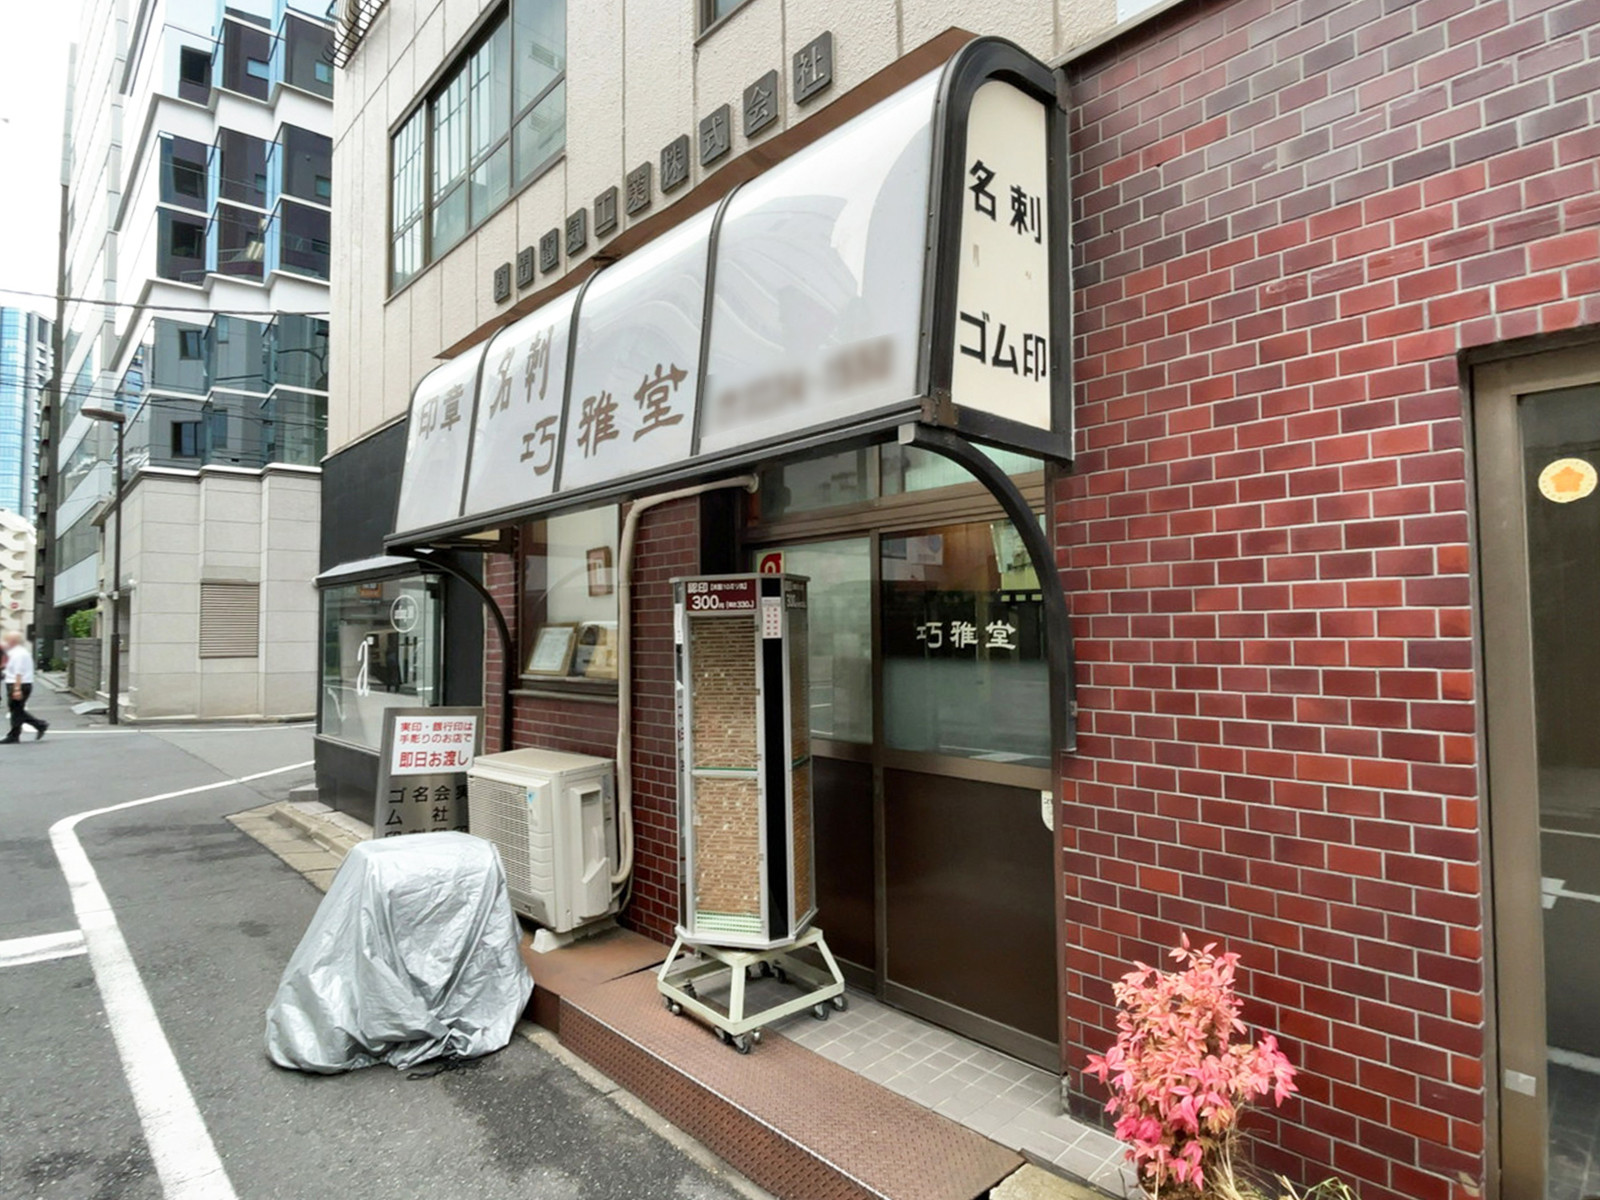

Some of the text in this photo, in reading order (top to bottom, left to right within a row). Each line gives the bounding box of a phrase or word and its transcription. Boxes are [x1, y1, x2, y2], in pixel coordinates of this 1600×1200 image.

[968, 159, 1042, 245] 名刺
[960, 311, 1047, 382] ゴム印
[418, 325, 554, 440] 印章 名刺
[520, 363, 688, 475] 巧雅堂
[916, 620, 1016, 650] 巧雅堂
[400, 733, 472, 744] 手彫りのお店で
[401, 722, 472, 732] 実印・銀行印は
[399, 750, 468, 767] 即日お渡し
[431, 785, 451, 831] 会社
